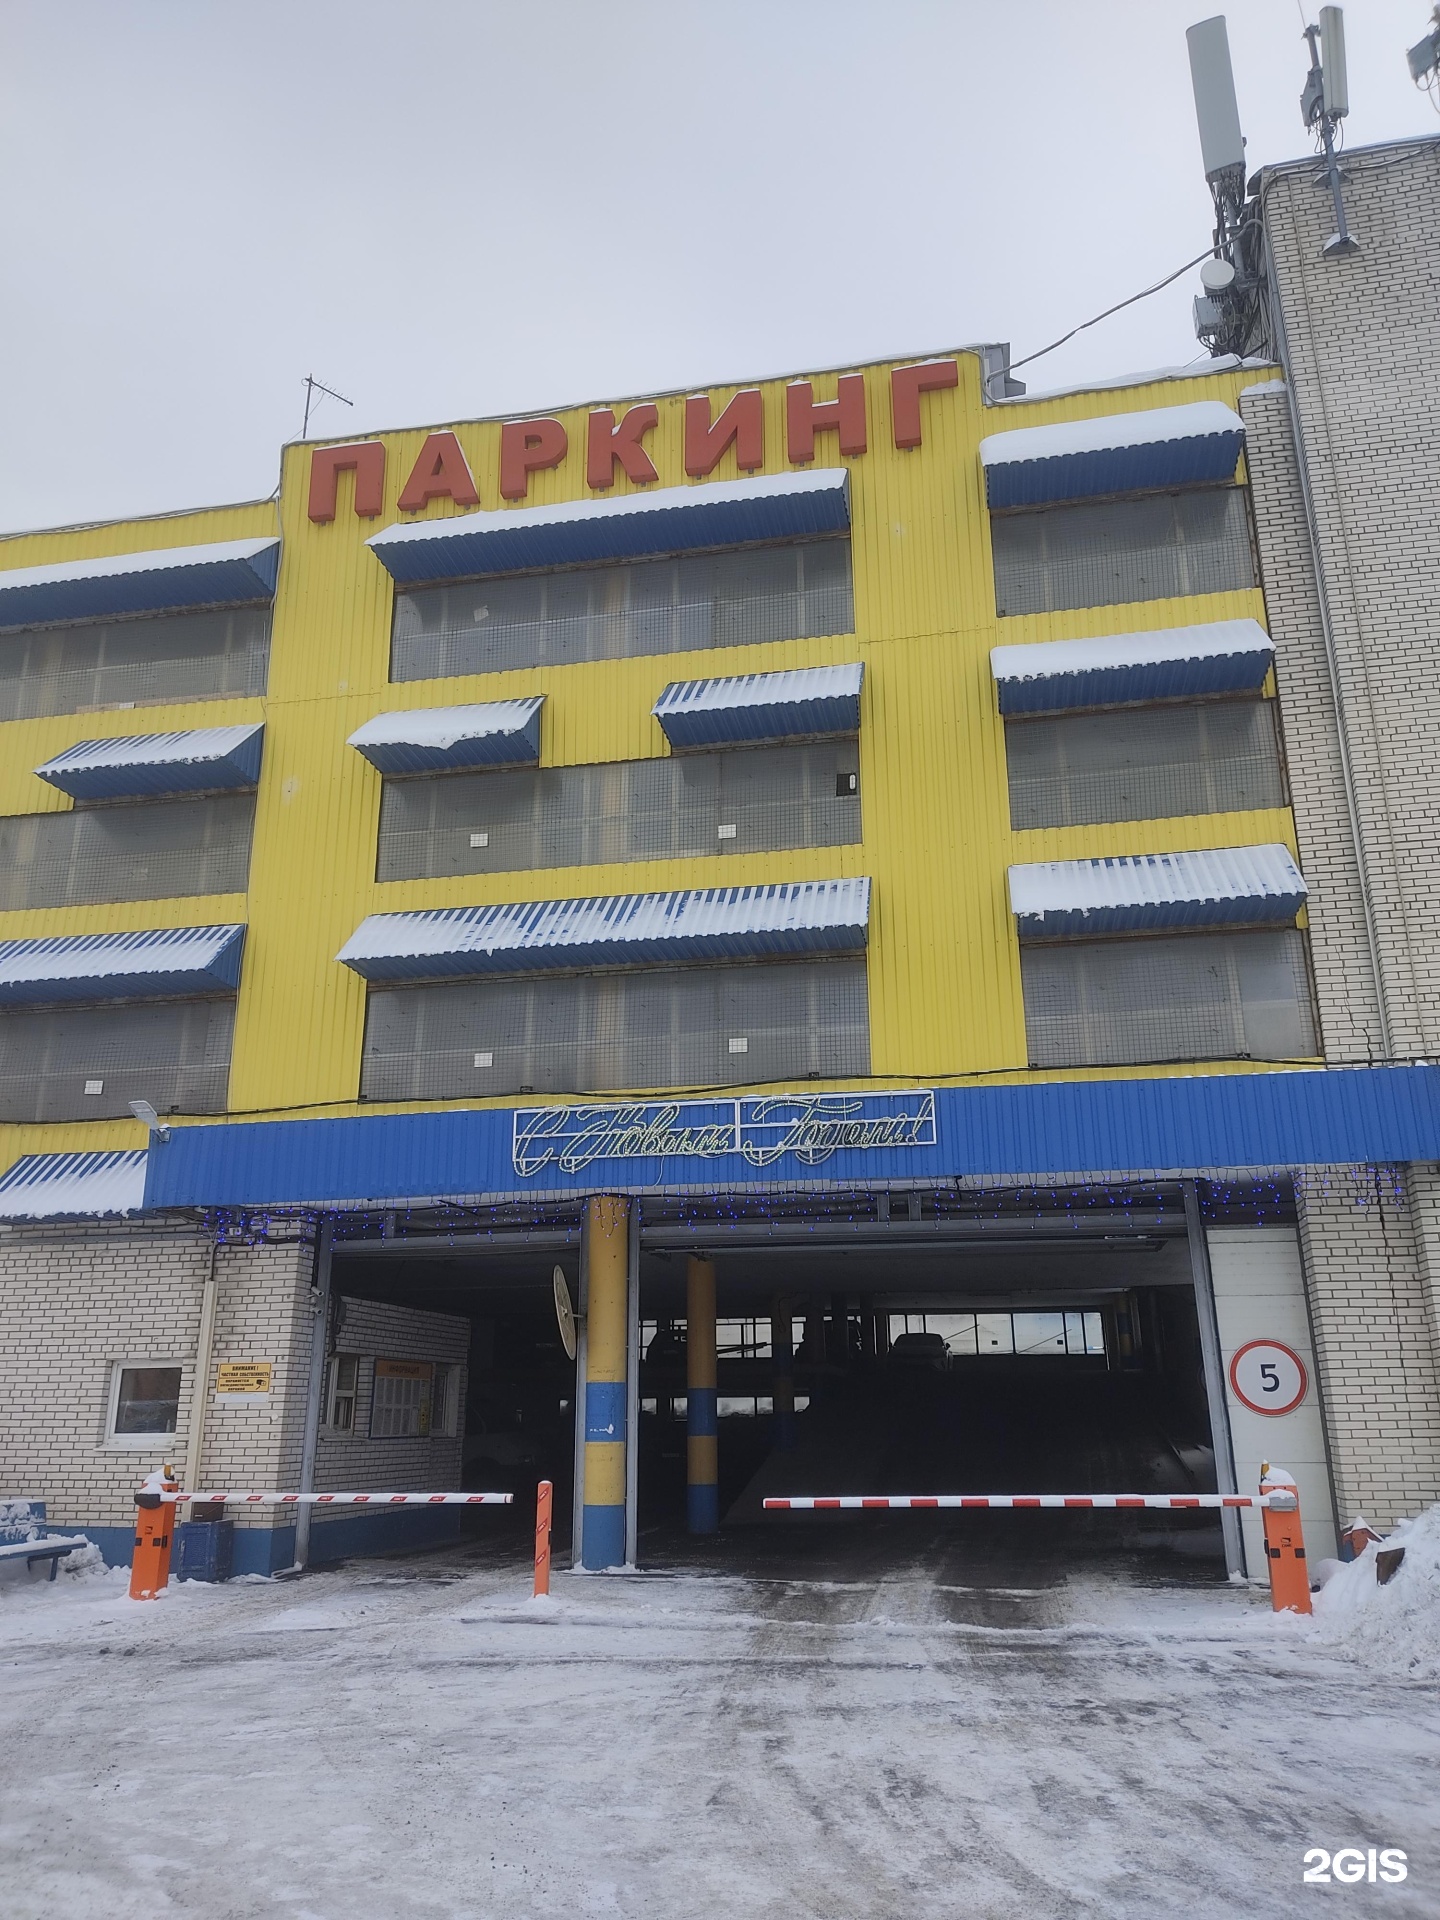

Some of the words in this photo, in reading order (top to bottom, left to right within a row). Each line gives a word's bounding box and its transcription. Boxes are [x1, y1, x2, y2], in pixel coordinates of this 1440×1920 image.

[308, 360, 958, 523] ПАРКИНГ
[514, 1104, 570, 1177] С
[559, 1104, 735, 1173] Новым
[743, 1096, 934, 1167] Годом!
[1260, 1363, 1280, 1393] 5
